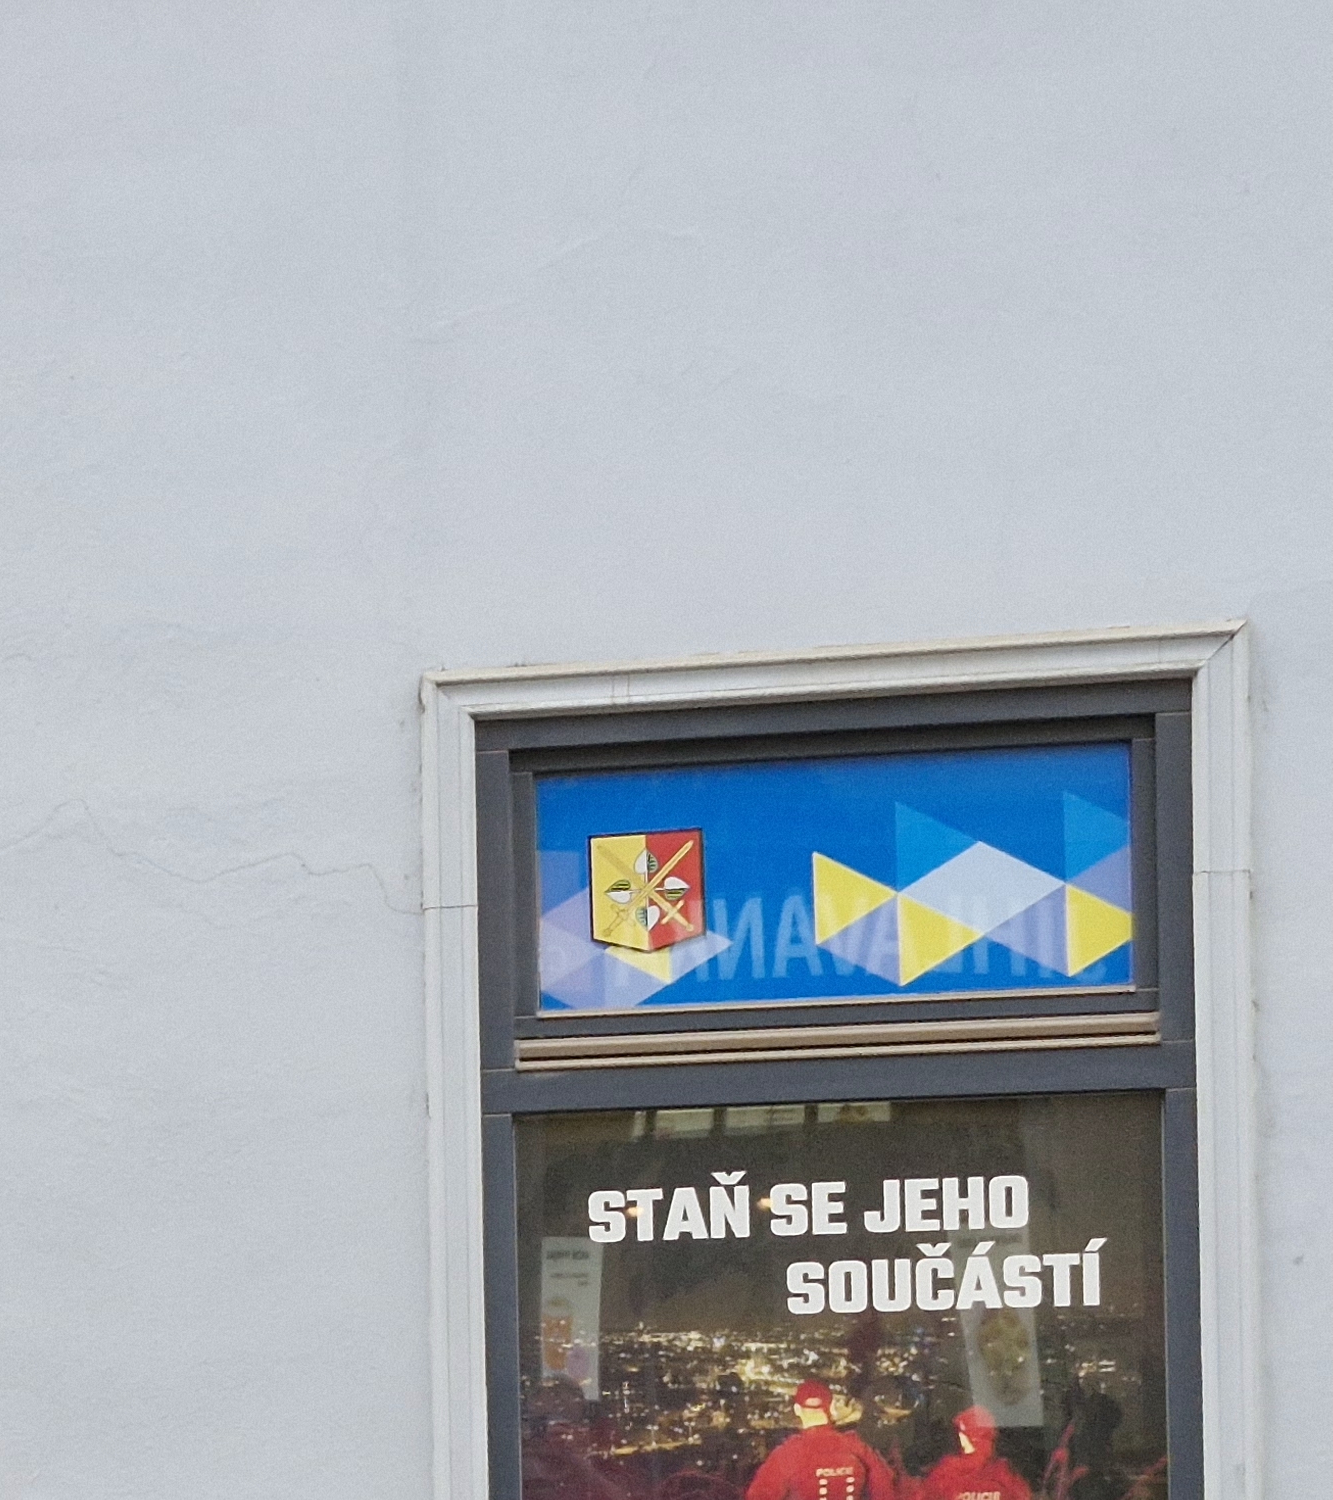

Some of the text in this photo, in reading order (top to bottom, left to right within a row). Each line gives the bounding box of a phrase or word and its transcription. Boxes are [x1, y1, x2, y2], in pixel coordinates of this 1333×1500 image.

[587, 1170, 1031, 1244] STAŇ SE JEHO
[786, 1236, 1109, 1316] SOUČÁSTÍ
